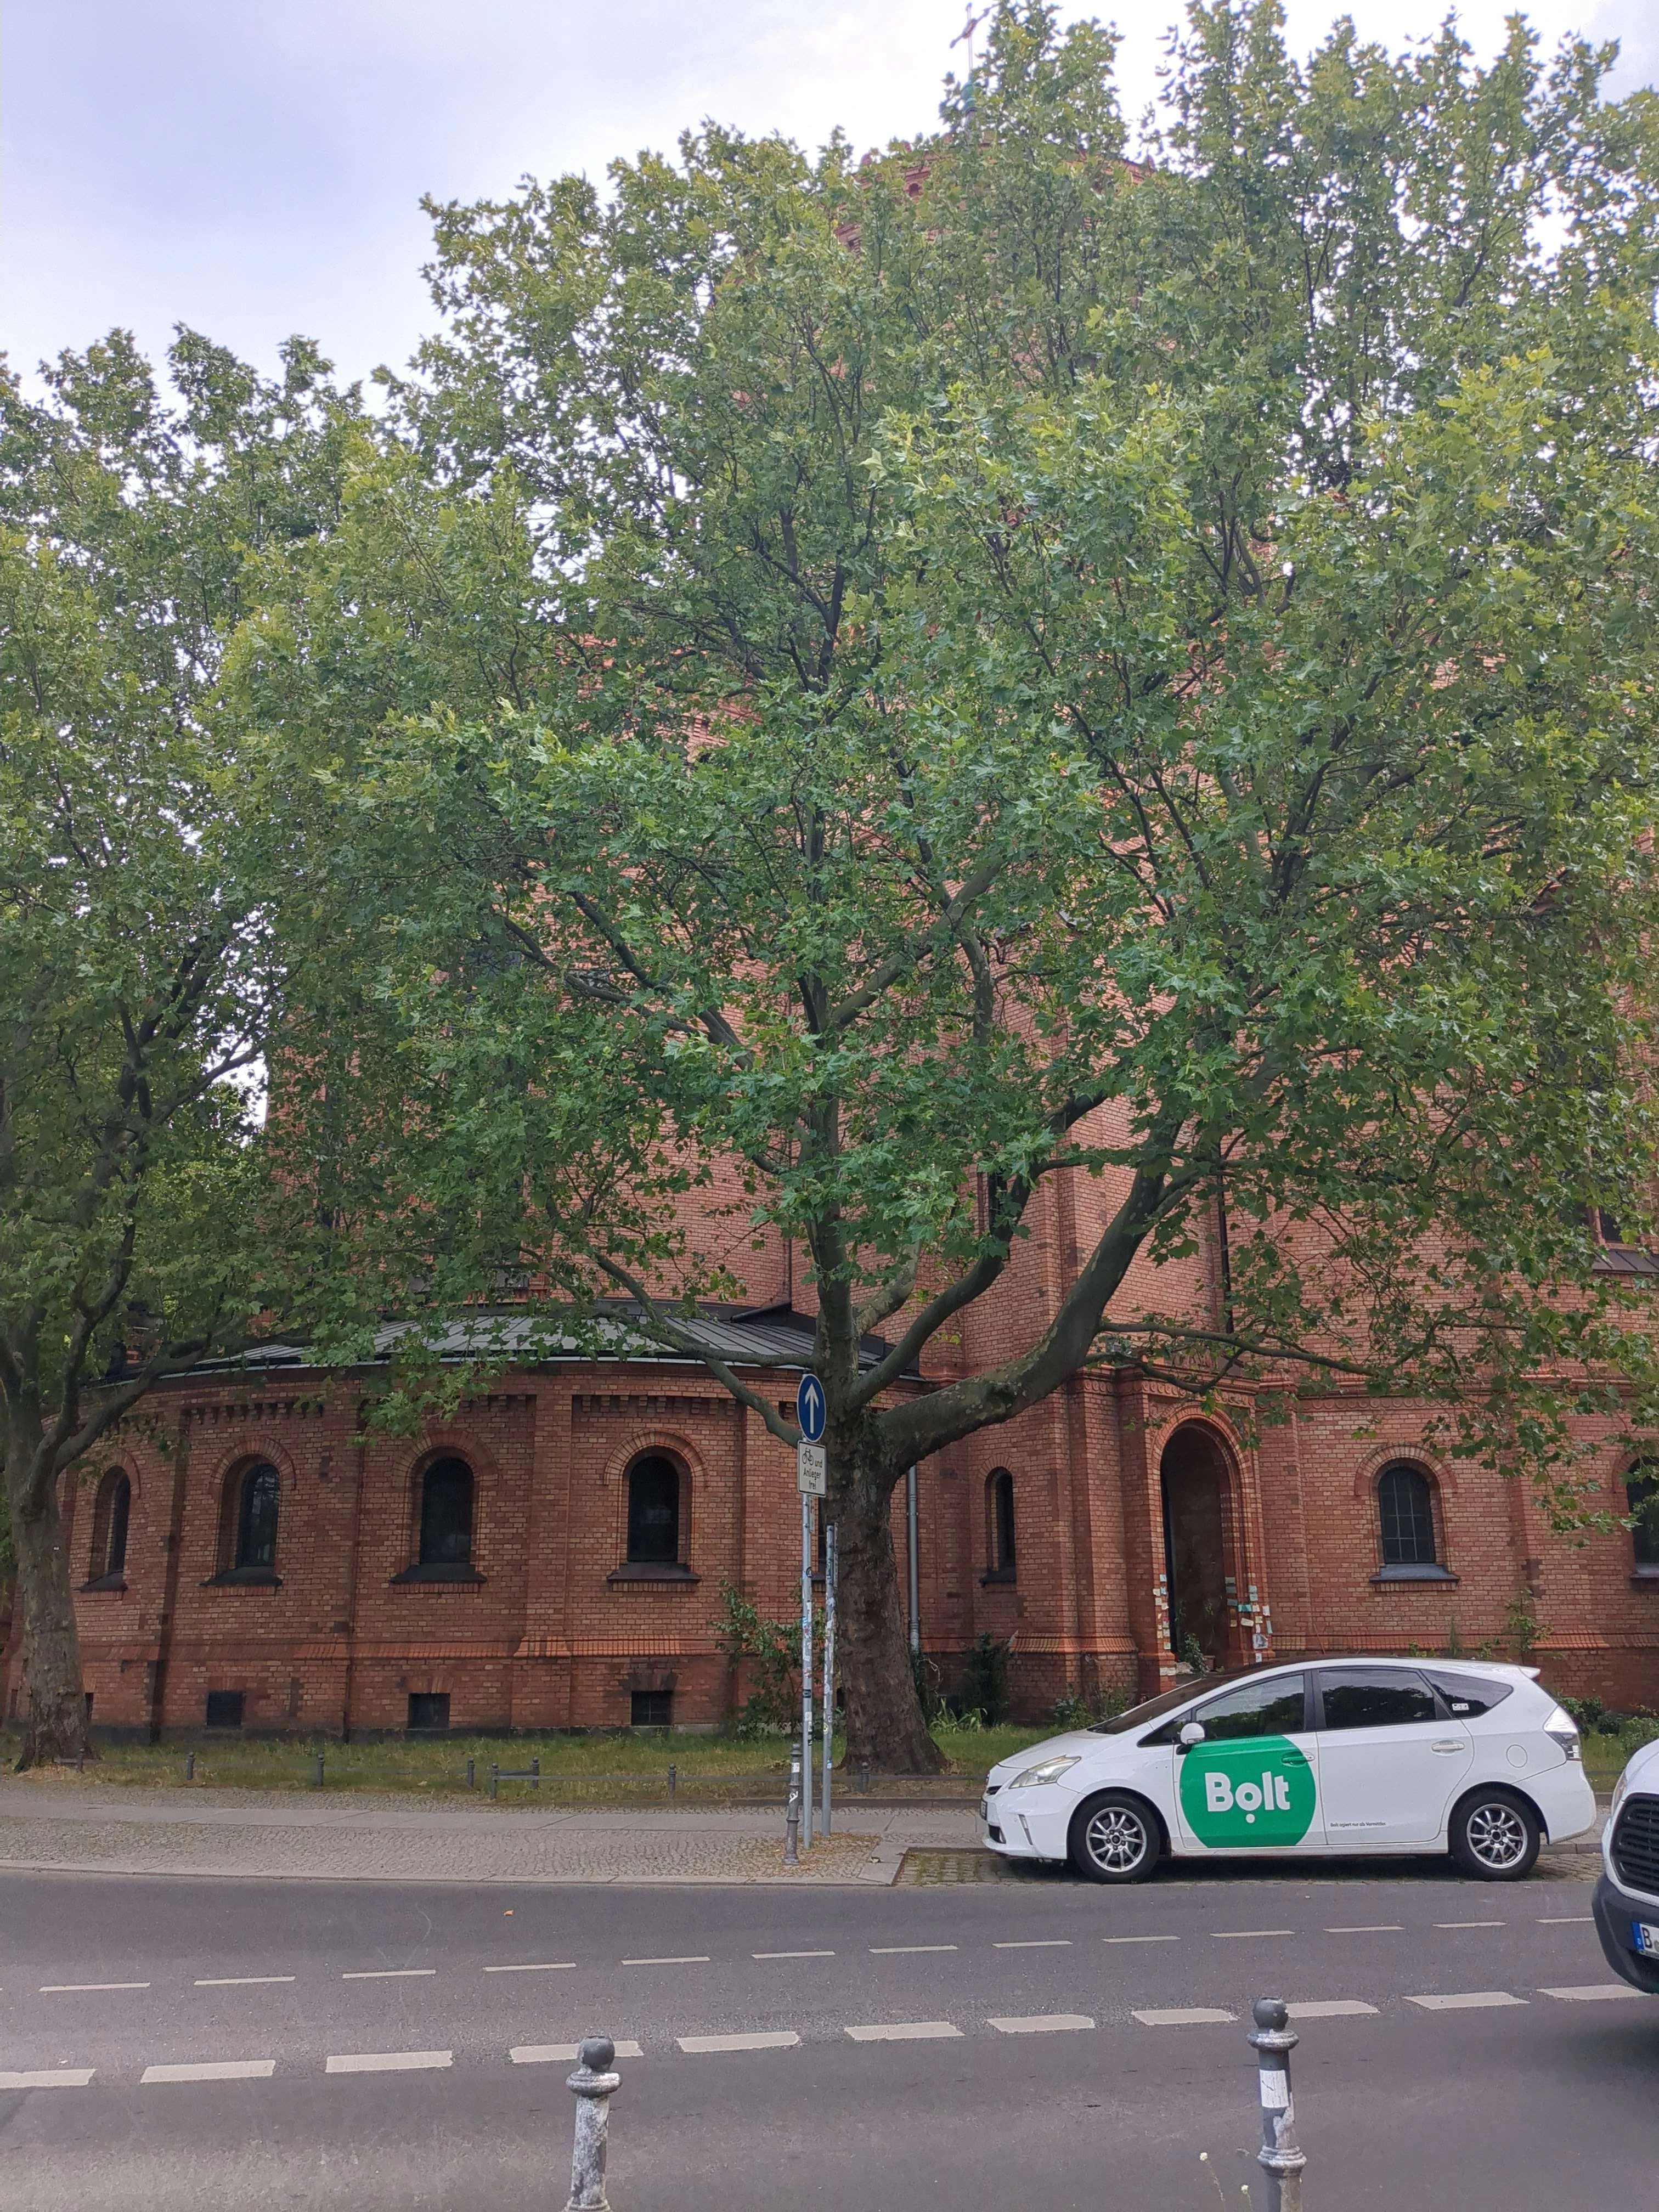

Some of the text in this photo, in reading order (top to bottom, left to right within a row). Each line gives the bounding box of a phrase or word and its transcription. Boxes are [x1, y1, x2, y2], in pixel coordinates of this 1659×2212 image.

[803, 1467, 821, 1480] Anlieger
[1205, 1771, 1291, 1812] Bolt
[1641, 1927, 1652, 1949] B
